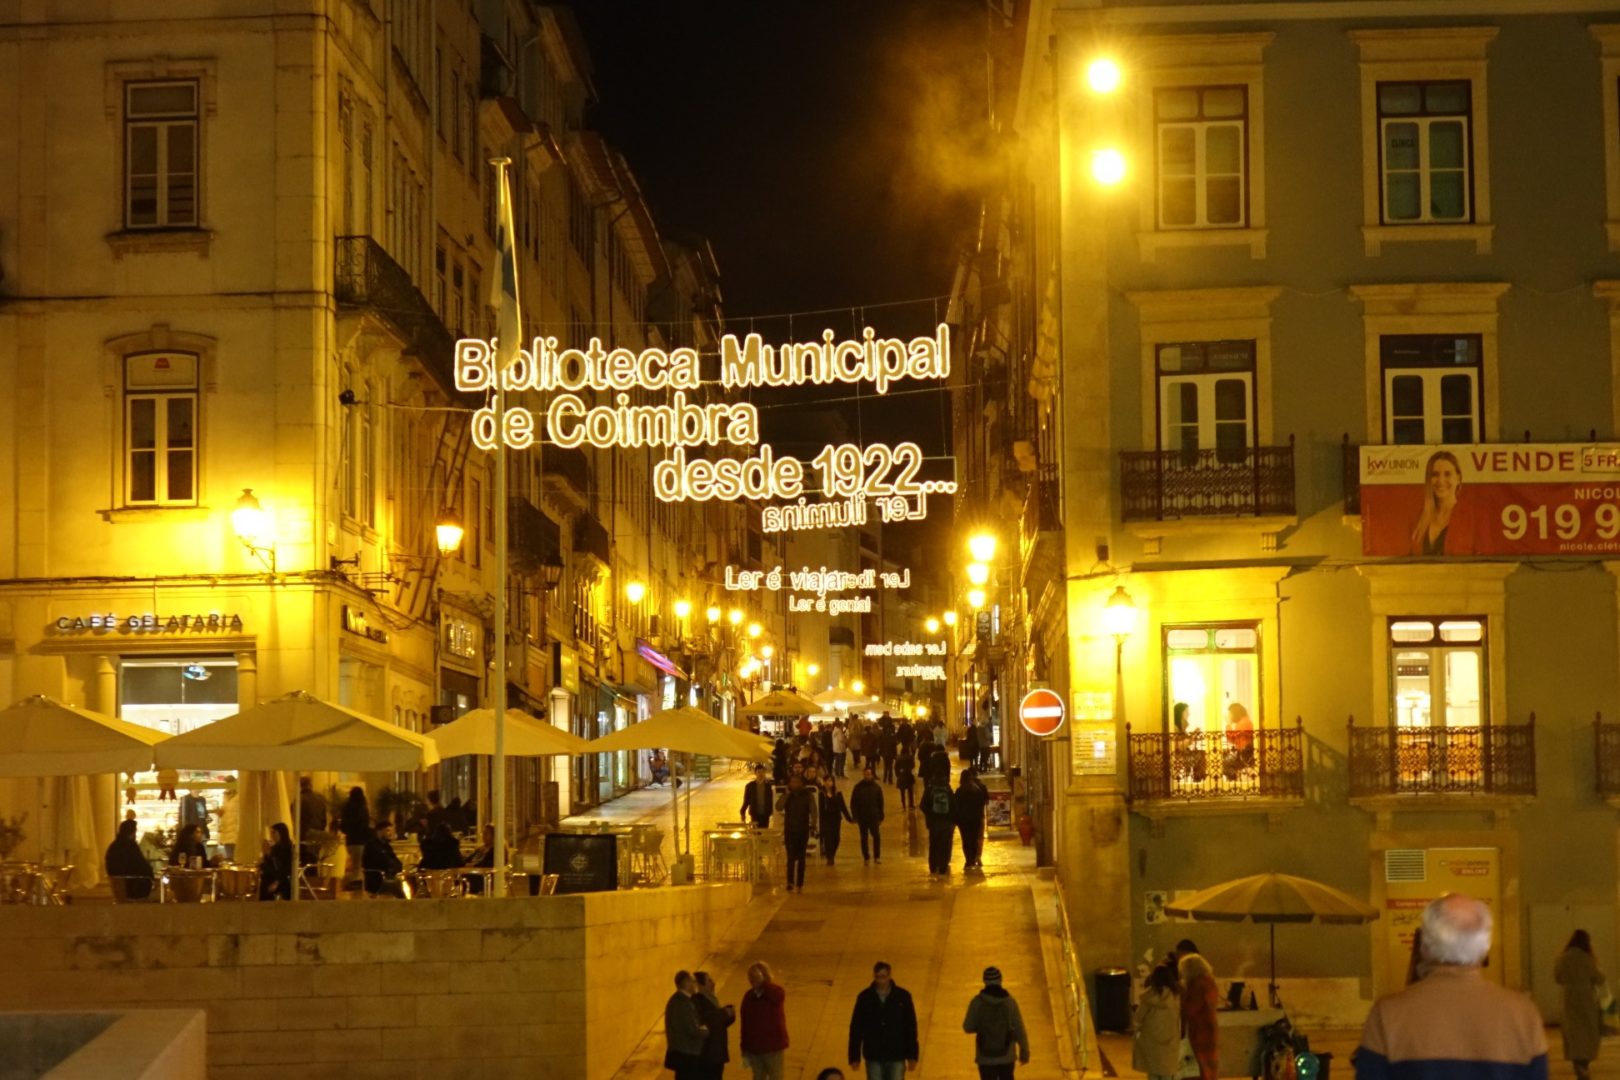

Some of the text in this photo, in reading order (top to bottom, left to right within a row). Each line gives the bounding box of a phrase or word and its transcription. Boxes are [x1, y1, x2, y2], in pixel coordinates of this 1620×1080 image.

[454, 323, 951, 395] Biblioteca Municipal
[471, 391, 759, 449] de Coimbra
[653, 442, 958, 501] desde 1922...
[1388, 459, 1420, 470] UNION
[1471, 451, 1575, 472] VENDE
[1584, 454, 1593, 467] 5
[1501, 503, 1581, 540] 919
[725, 566, 846, 597] Ler é viajar
[789, 595, 871, 616] Ler é genial
[57, 613, 243, 630] CAFÉ GELATARIA
